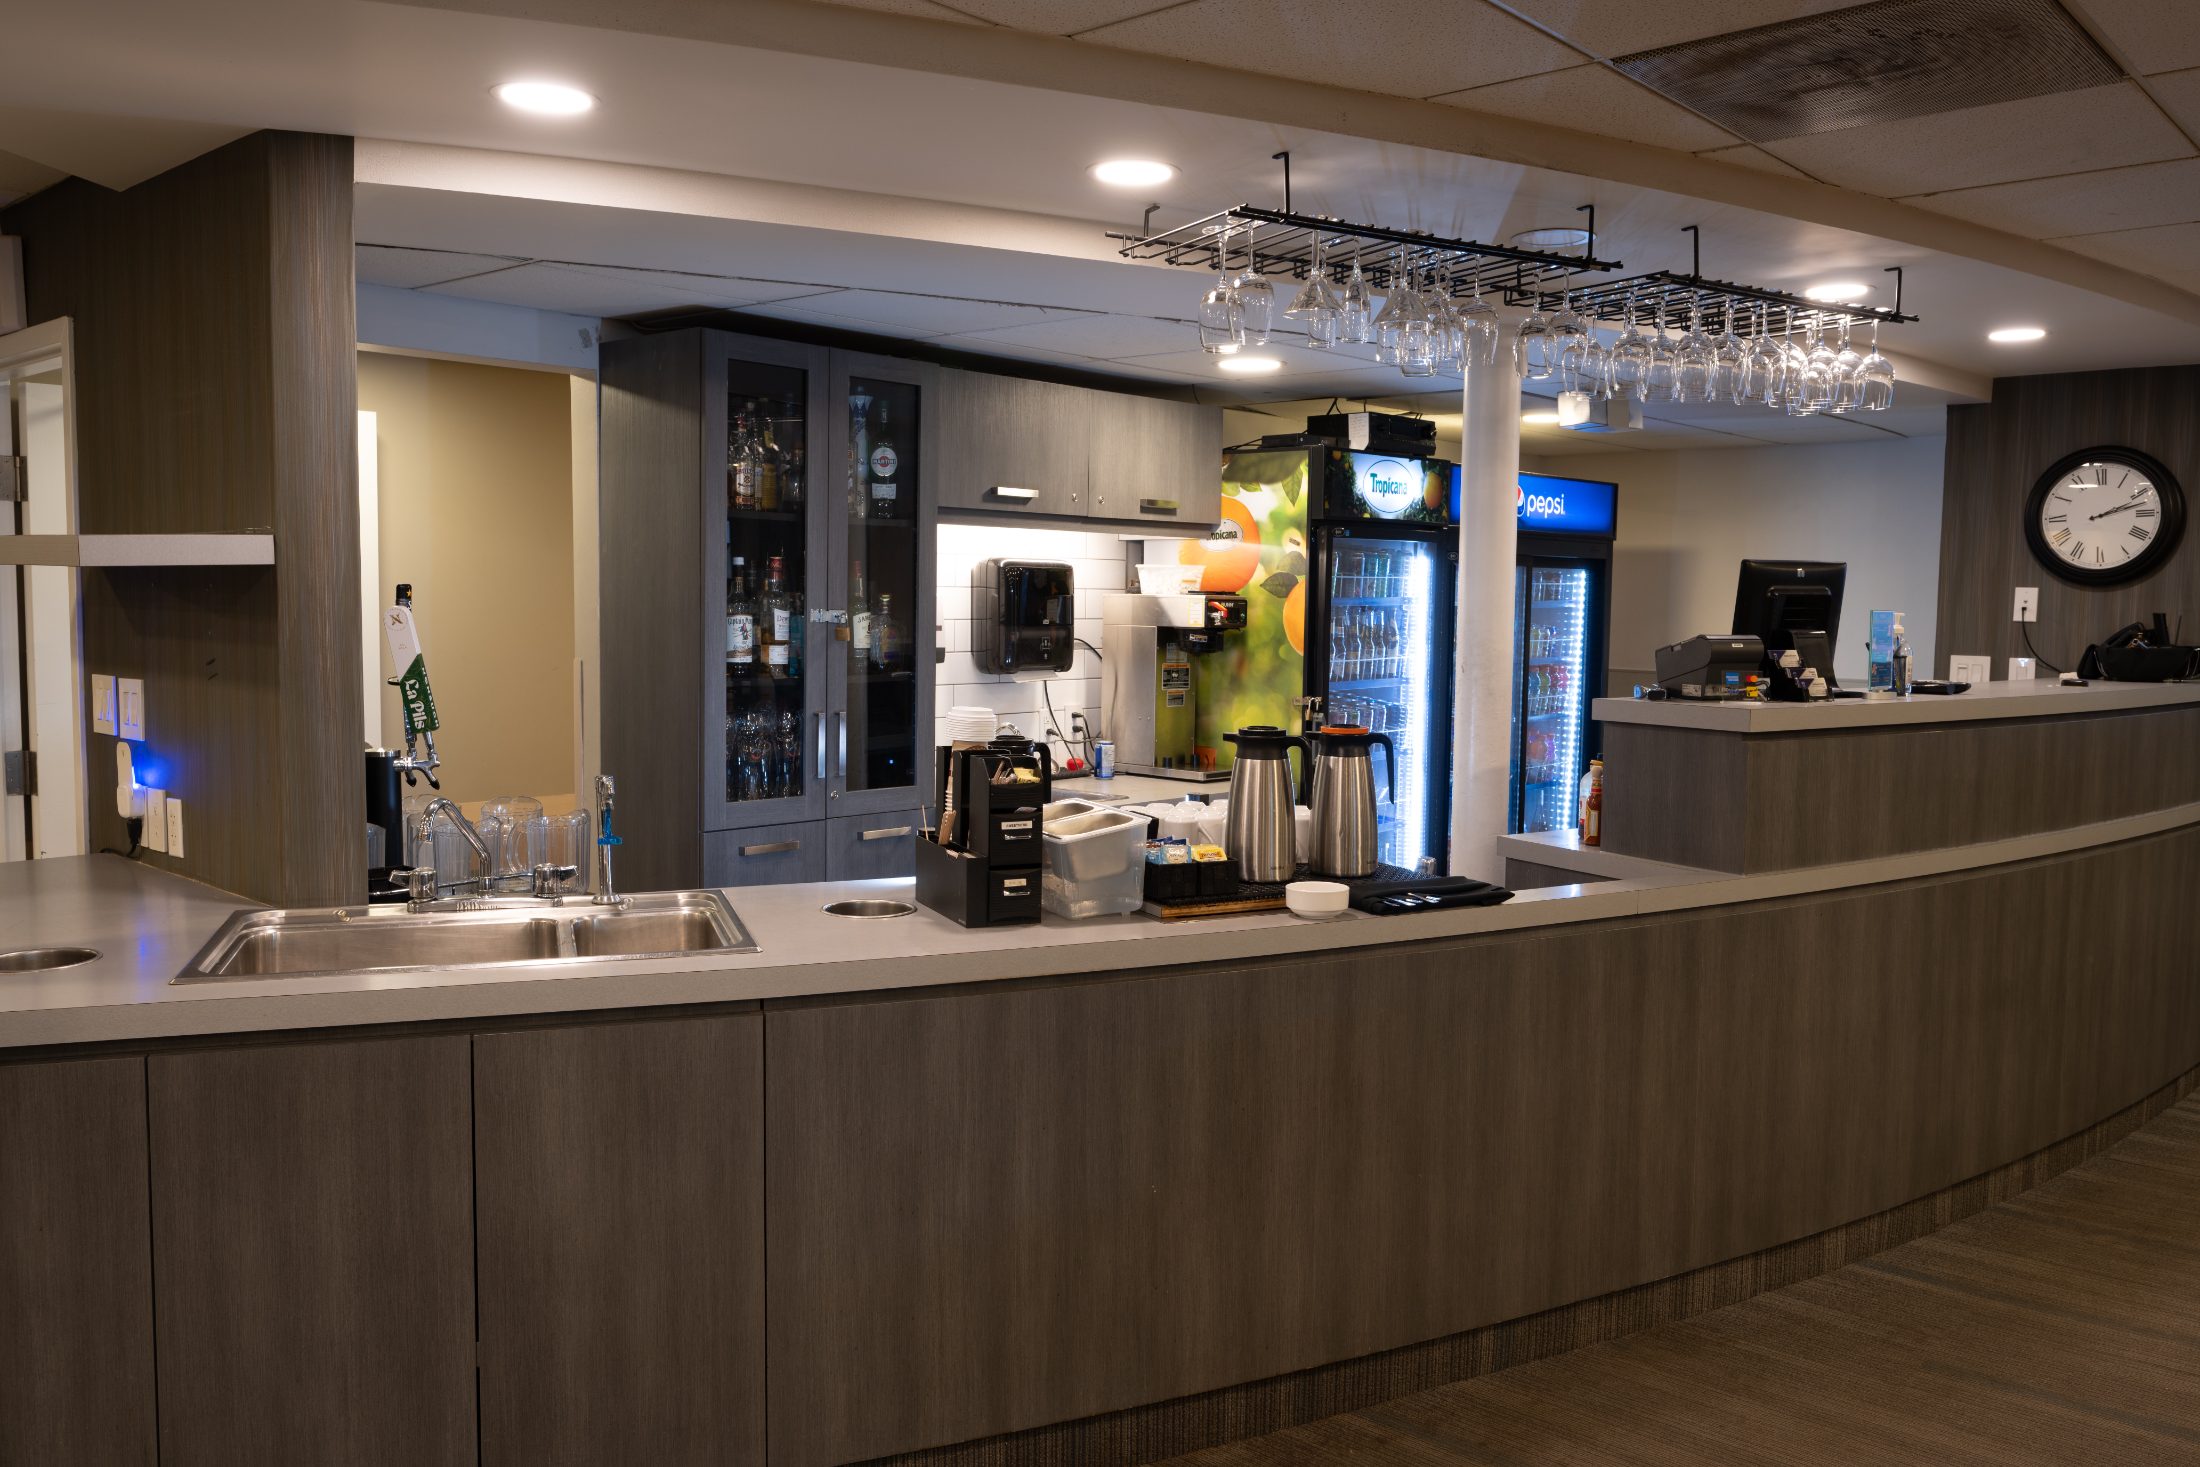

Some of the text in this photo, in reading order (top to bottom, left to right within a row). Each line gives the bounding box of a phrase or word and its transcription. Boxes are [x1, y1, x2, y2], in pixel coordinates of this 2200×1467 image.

[1370, 473, 1408, 498] Tropicana
[1527, 493, 1565, 519] pepsi
[1207, 529, 1238, 542] ropicana
[404, 679, 428, 729] La Pils
